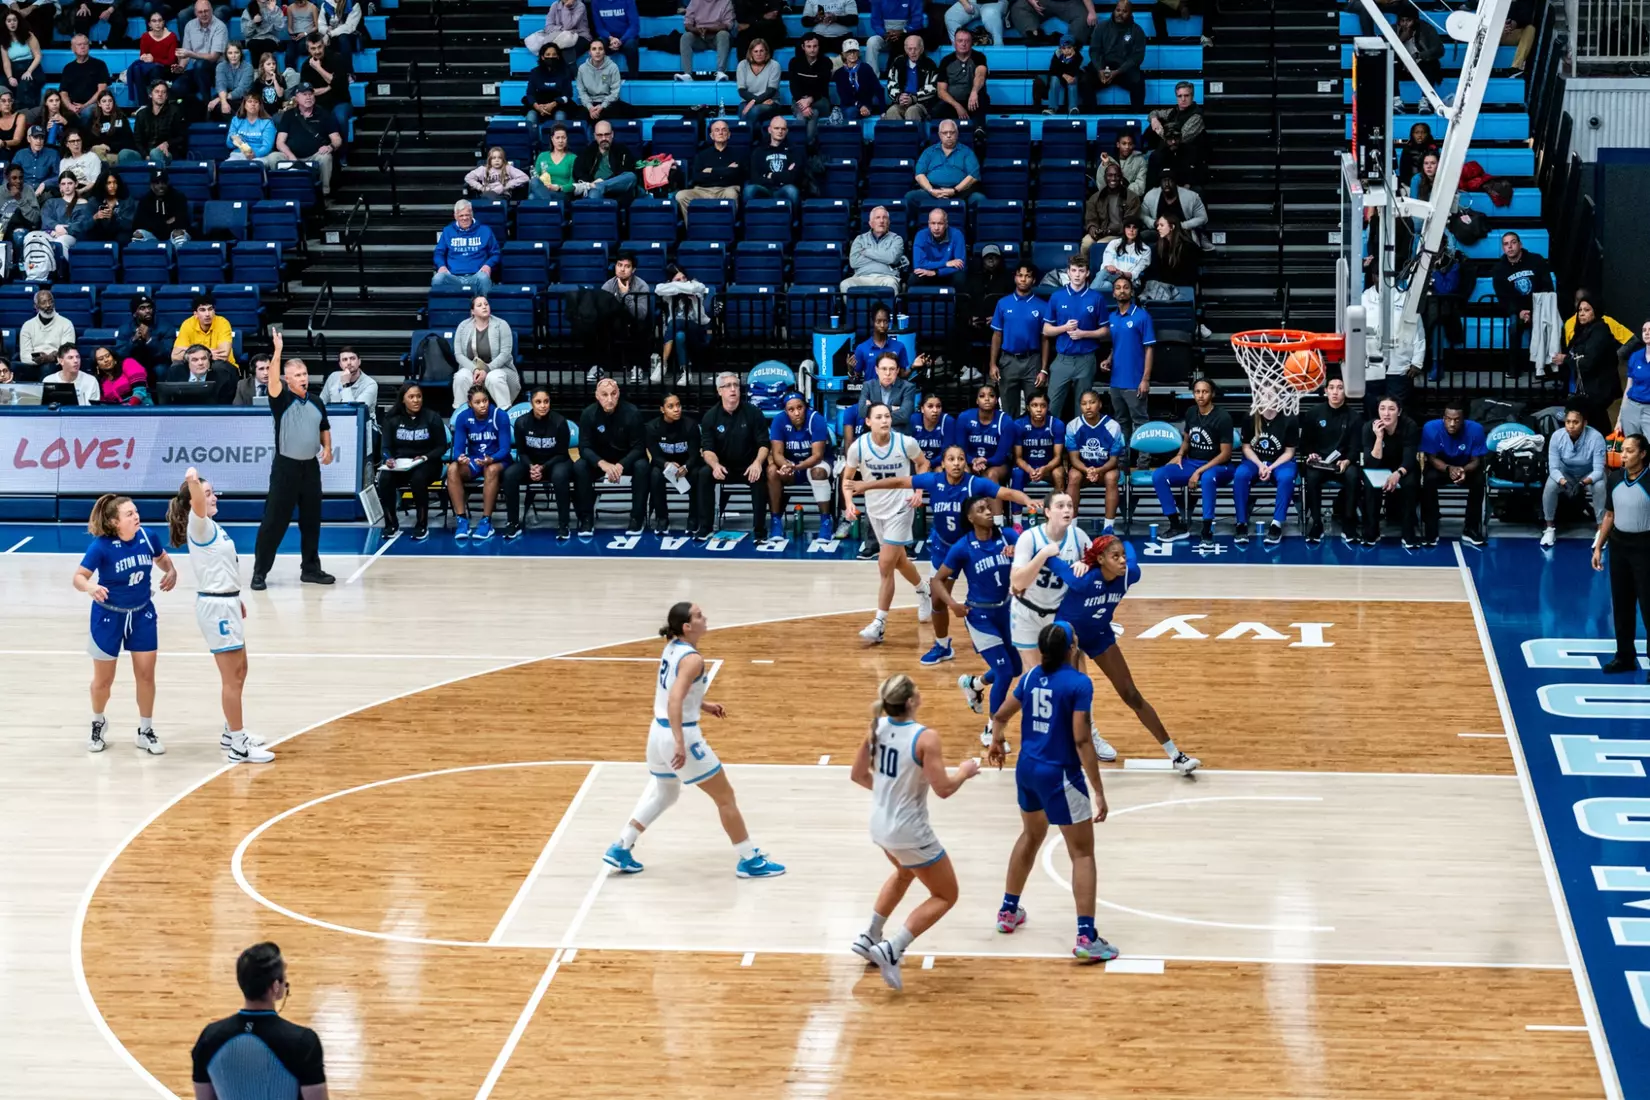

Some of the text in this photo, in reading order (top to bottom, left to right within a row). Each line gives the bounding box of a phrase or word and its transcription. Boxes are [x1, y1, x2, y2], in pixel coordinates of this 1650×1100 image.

[450, 237, 481, 247] SETON HALL
[753, 367, 788, 377] COLUMBIA
[1136, 429, 1175, 440] COLUMBIA
[13, 437, 136, 469] LOVE!
[946, 517, 957, 531] 5
[115, 555, 137, 573] SETON
[974, 556, 995, 574] SETON
[127, 571, 145, 587] 10
[993, 571, 1003, 587] 1
[1084, 594, 1105, 607] SETON
[1091, 608, 1107, 619] 2
[218, 620, 230, 635] C
[1135, 614, 1336, 647] Ivy
[1031, 687, 1053, 719] 15
[690, 742, 706, 760] C
[879, 744, 898, 778] 10
